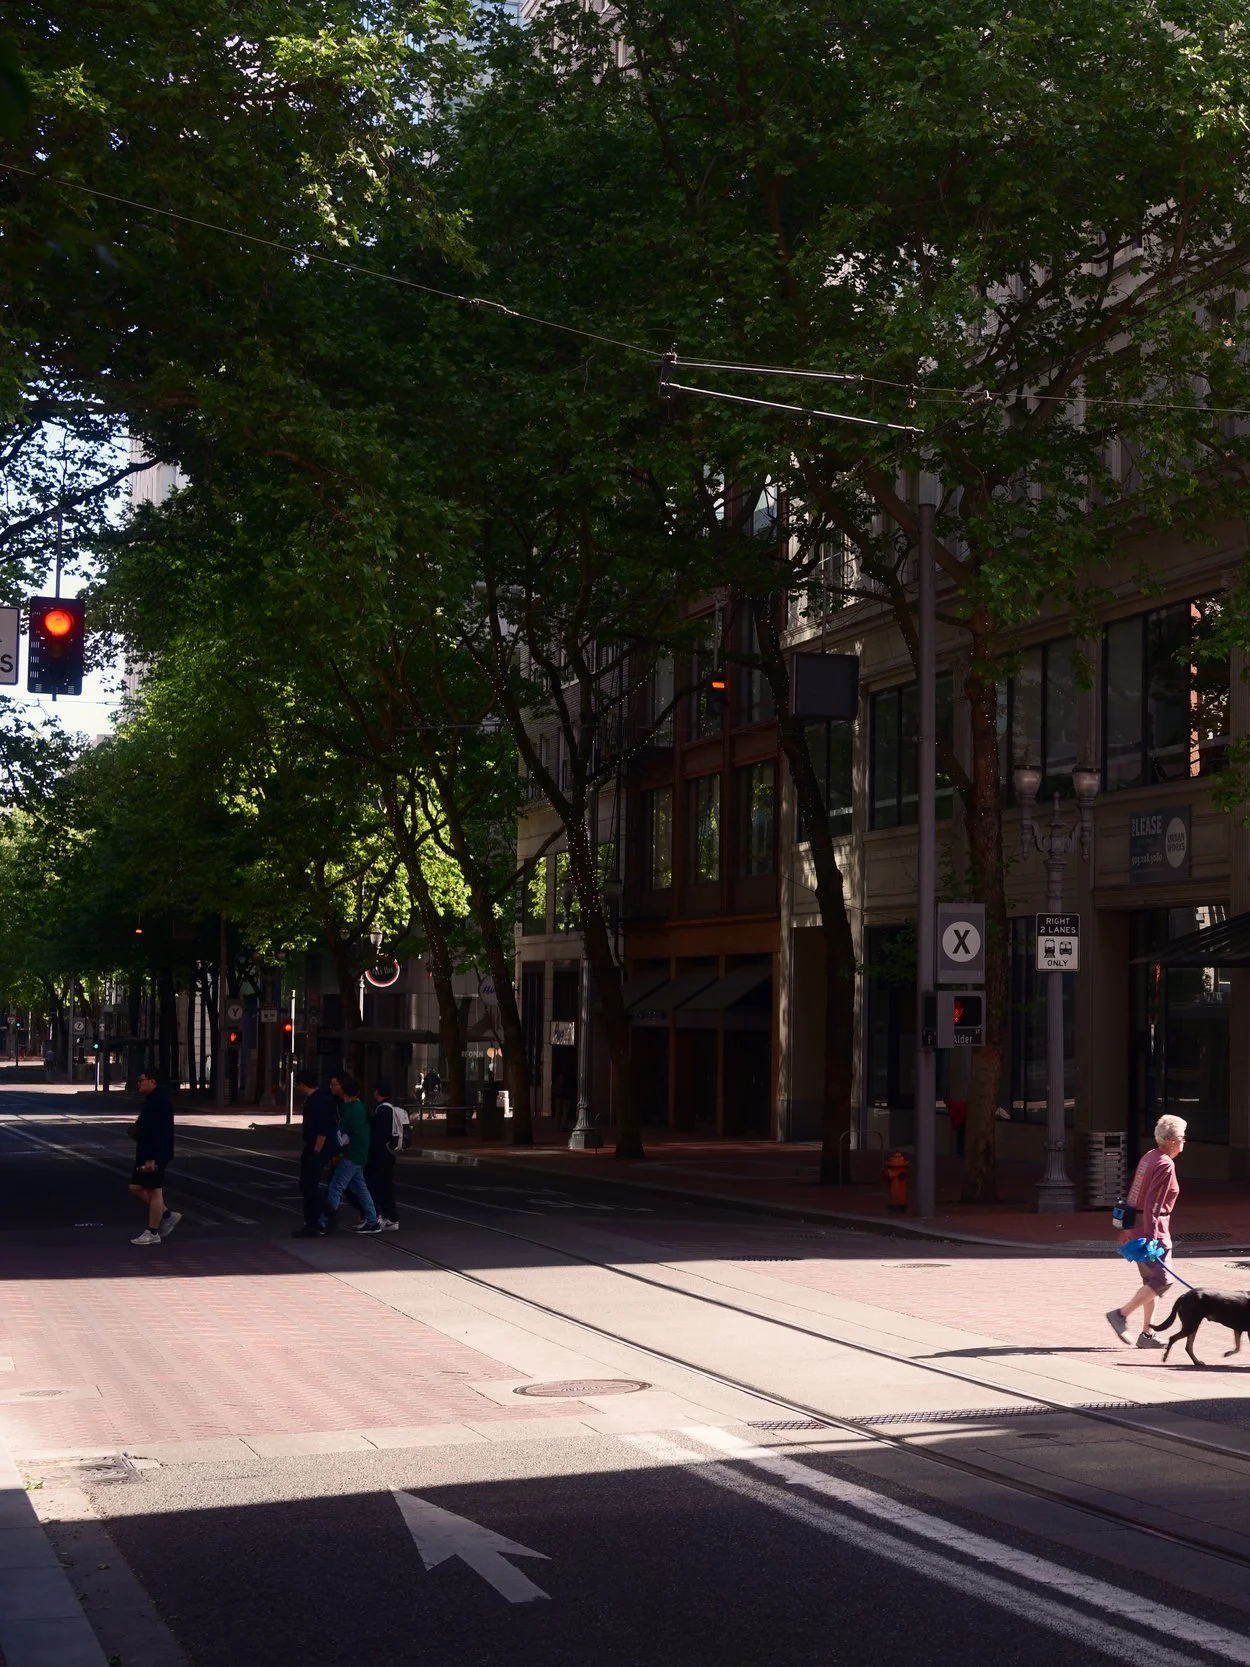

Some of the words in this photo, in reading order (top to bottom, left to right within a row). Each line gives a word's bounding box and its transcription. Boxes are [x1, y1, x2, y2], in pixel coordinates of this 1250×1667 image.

[1135, 815, 1163, 837] LEASE
[1167, 832, 1185, 843] URBAN
[1045, 917, 1070, 925] RIGHT
[1048, 926, 1076, 934] LANES
[952, 929, 970, 954] X
[1047, 959, 1068, 967] ONLY
